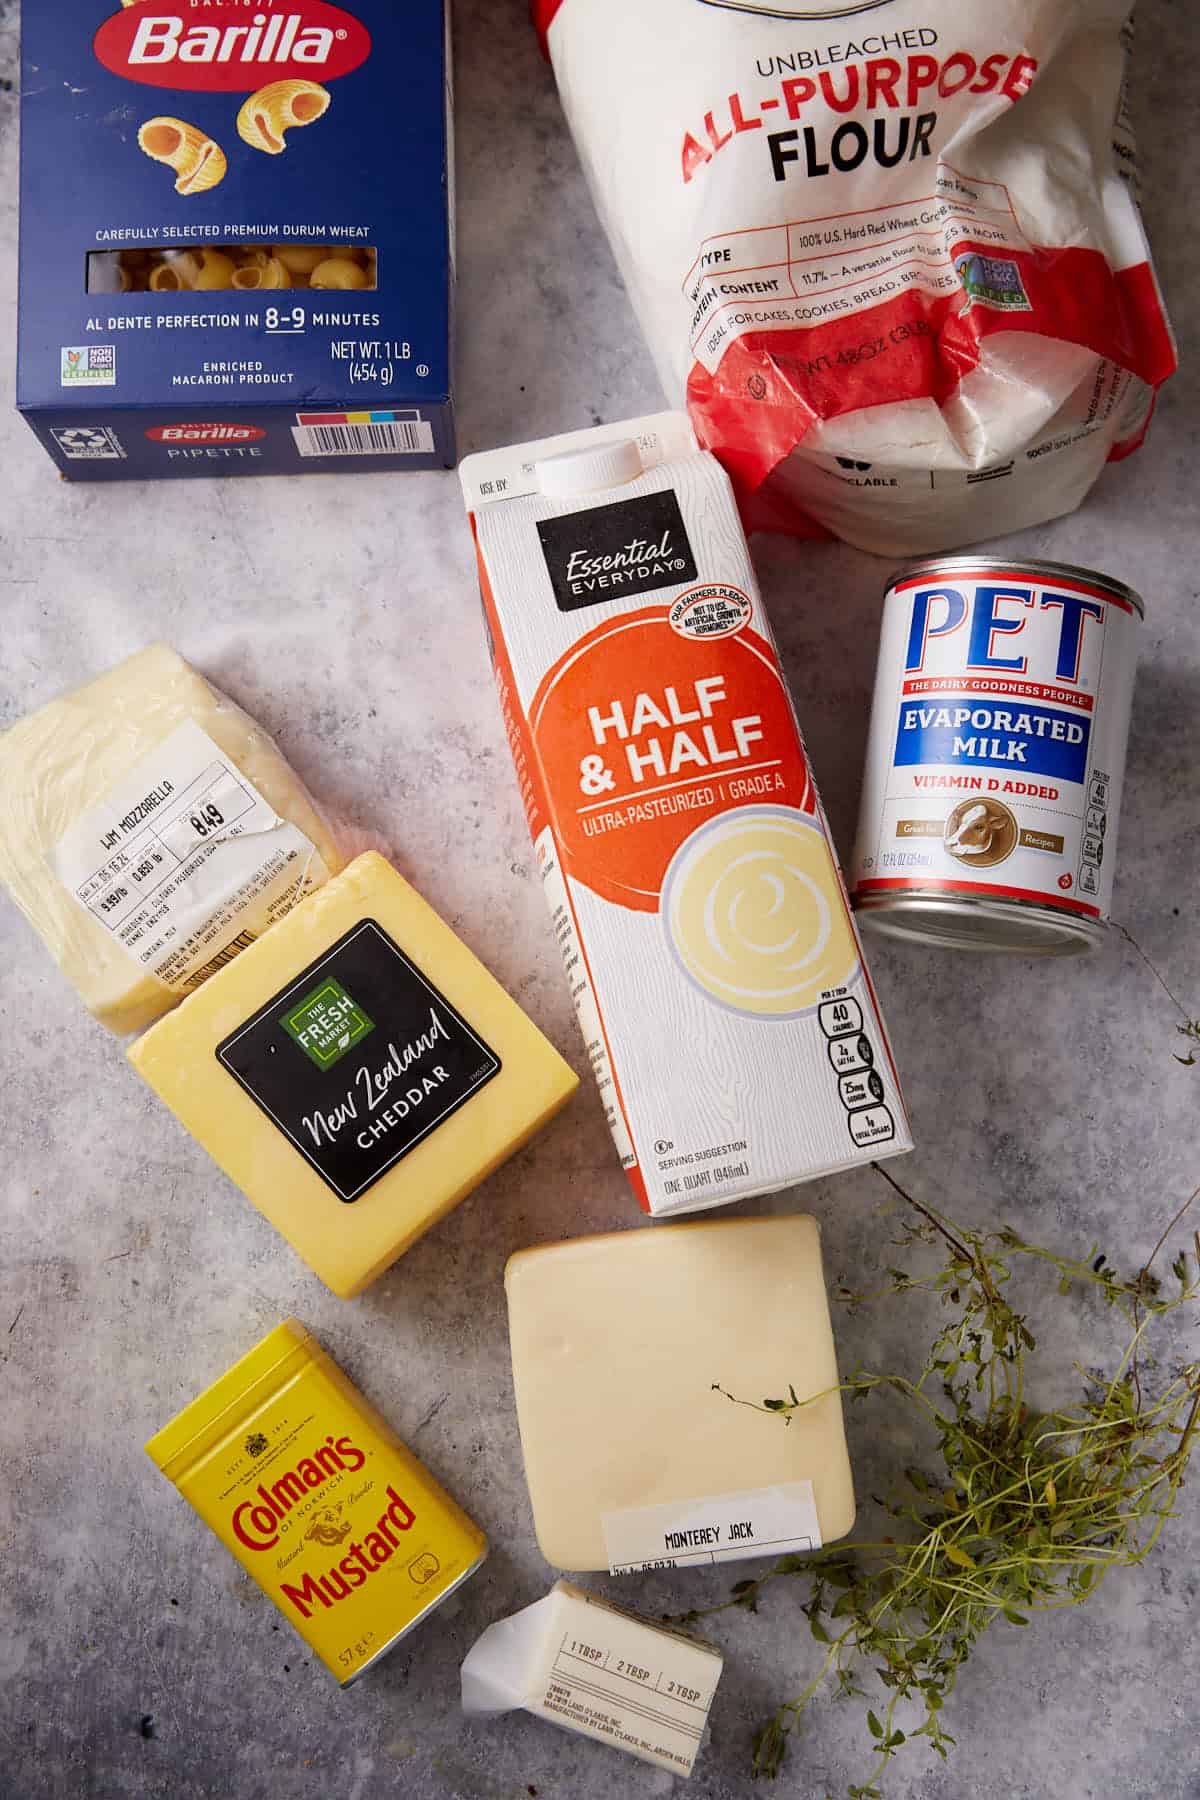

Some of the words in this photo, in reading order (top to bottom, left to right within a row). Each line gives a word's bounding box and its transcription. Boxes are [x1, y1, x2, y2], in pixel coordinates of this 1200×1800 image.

[756, 28, 938, 77] UNBLEACHED
[681, 51, 1038, 184] ALL-PURPOSE
[768, 112, 938, 181] FLOUR
[96, 226, 159, 240] CAREFULLY
[162, 225, 220, 238] SELECTED
[224, 224, 279, 237] PREMIUM
[283, 224, 327, 237] DURUM
[329, 225, 370, 237] WHEAT
[800, 233, 822, 248] 100%
[824, 230, 842, 245] U.S.
[844, 226, 867, 240] Hard
[868, 222, 886, 236] Red
[887, 216, 919, 231] Wheat
[974, 228, 1009, 241] MORE
[720, 280, 780, 295] CONTENT
[86, 317, 104, 330] AL
[108, 315, 153, 330] DENTE
[157, 314, 240, 328] PERFECTION
[244, 313, 259, 326] IN
[265, 308, 305, 329] 8-9
[312, 312, 380, 326] MINUTES
[728, 312, 754, 328] FOR
[89, 348, 112, 356] NON
[89, 355, 113, 363] GMO
[331, 341, 356, 360] NET
[359, 341, 382, 360] WT.
[385, 342, 391, 359] 1
[394, 342, 411, 360] LB
[203, 361, 263, 372] ENRICHED
[349, 363, 378, 384] (454
[380, 363, 394, 385] g)
[172, 374, 235, 386] MACARONI
[239, 373, 294, 384] PRODUCT
[167, 446, 264, 459] PIPETTE
[479, 480, 494, 496] USE
[496, 478, 507, 493] BY
[566, 530, 673, 582] Essential
[682, 588, 717, 606] FARMERS
[904, 586, 1105, 685] PET
[911, 681, 929, 691] THE
[932, 680, 968, 690] DAIRY
[972, 681, 1040, 696] GOODNESS
[1043, 688, 1084, 705] PEOPLE
[588, 675, 727, 745] HALF
[903, 708, 1084, 744] EVAPORATED
[578, 754, 616, 796] &
[625, 715, 763, 784] HALF
[952, 736, 1028, 763] MILK
[913, 775, 982, 790] VITAMIN
[987, 778, 1000, 791] D
[1003, 780, 1059, 801] ADDED
[118, 780, 175, 834] MOZZARELLA
[583, 787, 715, 837] ULTRA-PASTEURIZED
[730, 778, 772, 799] GRADE
[774, 772, 785, 790] A
[190, 804, 224, 836] 8.49
[131, 860, 154, 882] 0.850
[297, 996, 355, 1049] FRESH
[307, 1002, 326, 1020] THE
[833, 1004, 849, 1021] 40
[317, 1018, 352, 1048] MARKET
[302, 1092, 358, 1146] New
[355, 1008, 451, 1112] Zealand
[356, 1065, 450, 1150] CHEDDAR
[658, 1154, 694, 1170] SERVING
[694, 1140, 748, 1161] SUGGESTION
[664, 1181, 682, 1195] ONE
[683, 1171, 712, 1190] QUART
[232, 1435, 366, 1552] Colman's
[665, 1526, 720, 1550] MONTEREY
[728, 1521, 754, 1541] JACK
[279, 1485, 417, 1619] Mustard
[338, 1647, 353, 1667] 57
[578, 1643, 602, 1661] TBSP
[617, 1660, 625, 1671] 2
[626, 1663, 650, 1681] TBSP
[667, 1681, 675, 1692] 3
[676, 1685, 701, 1702] TBSP
